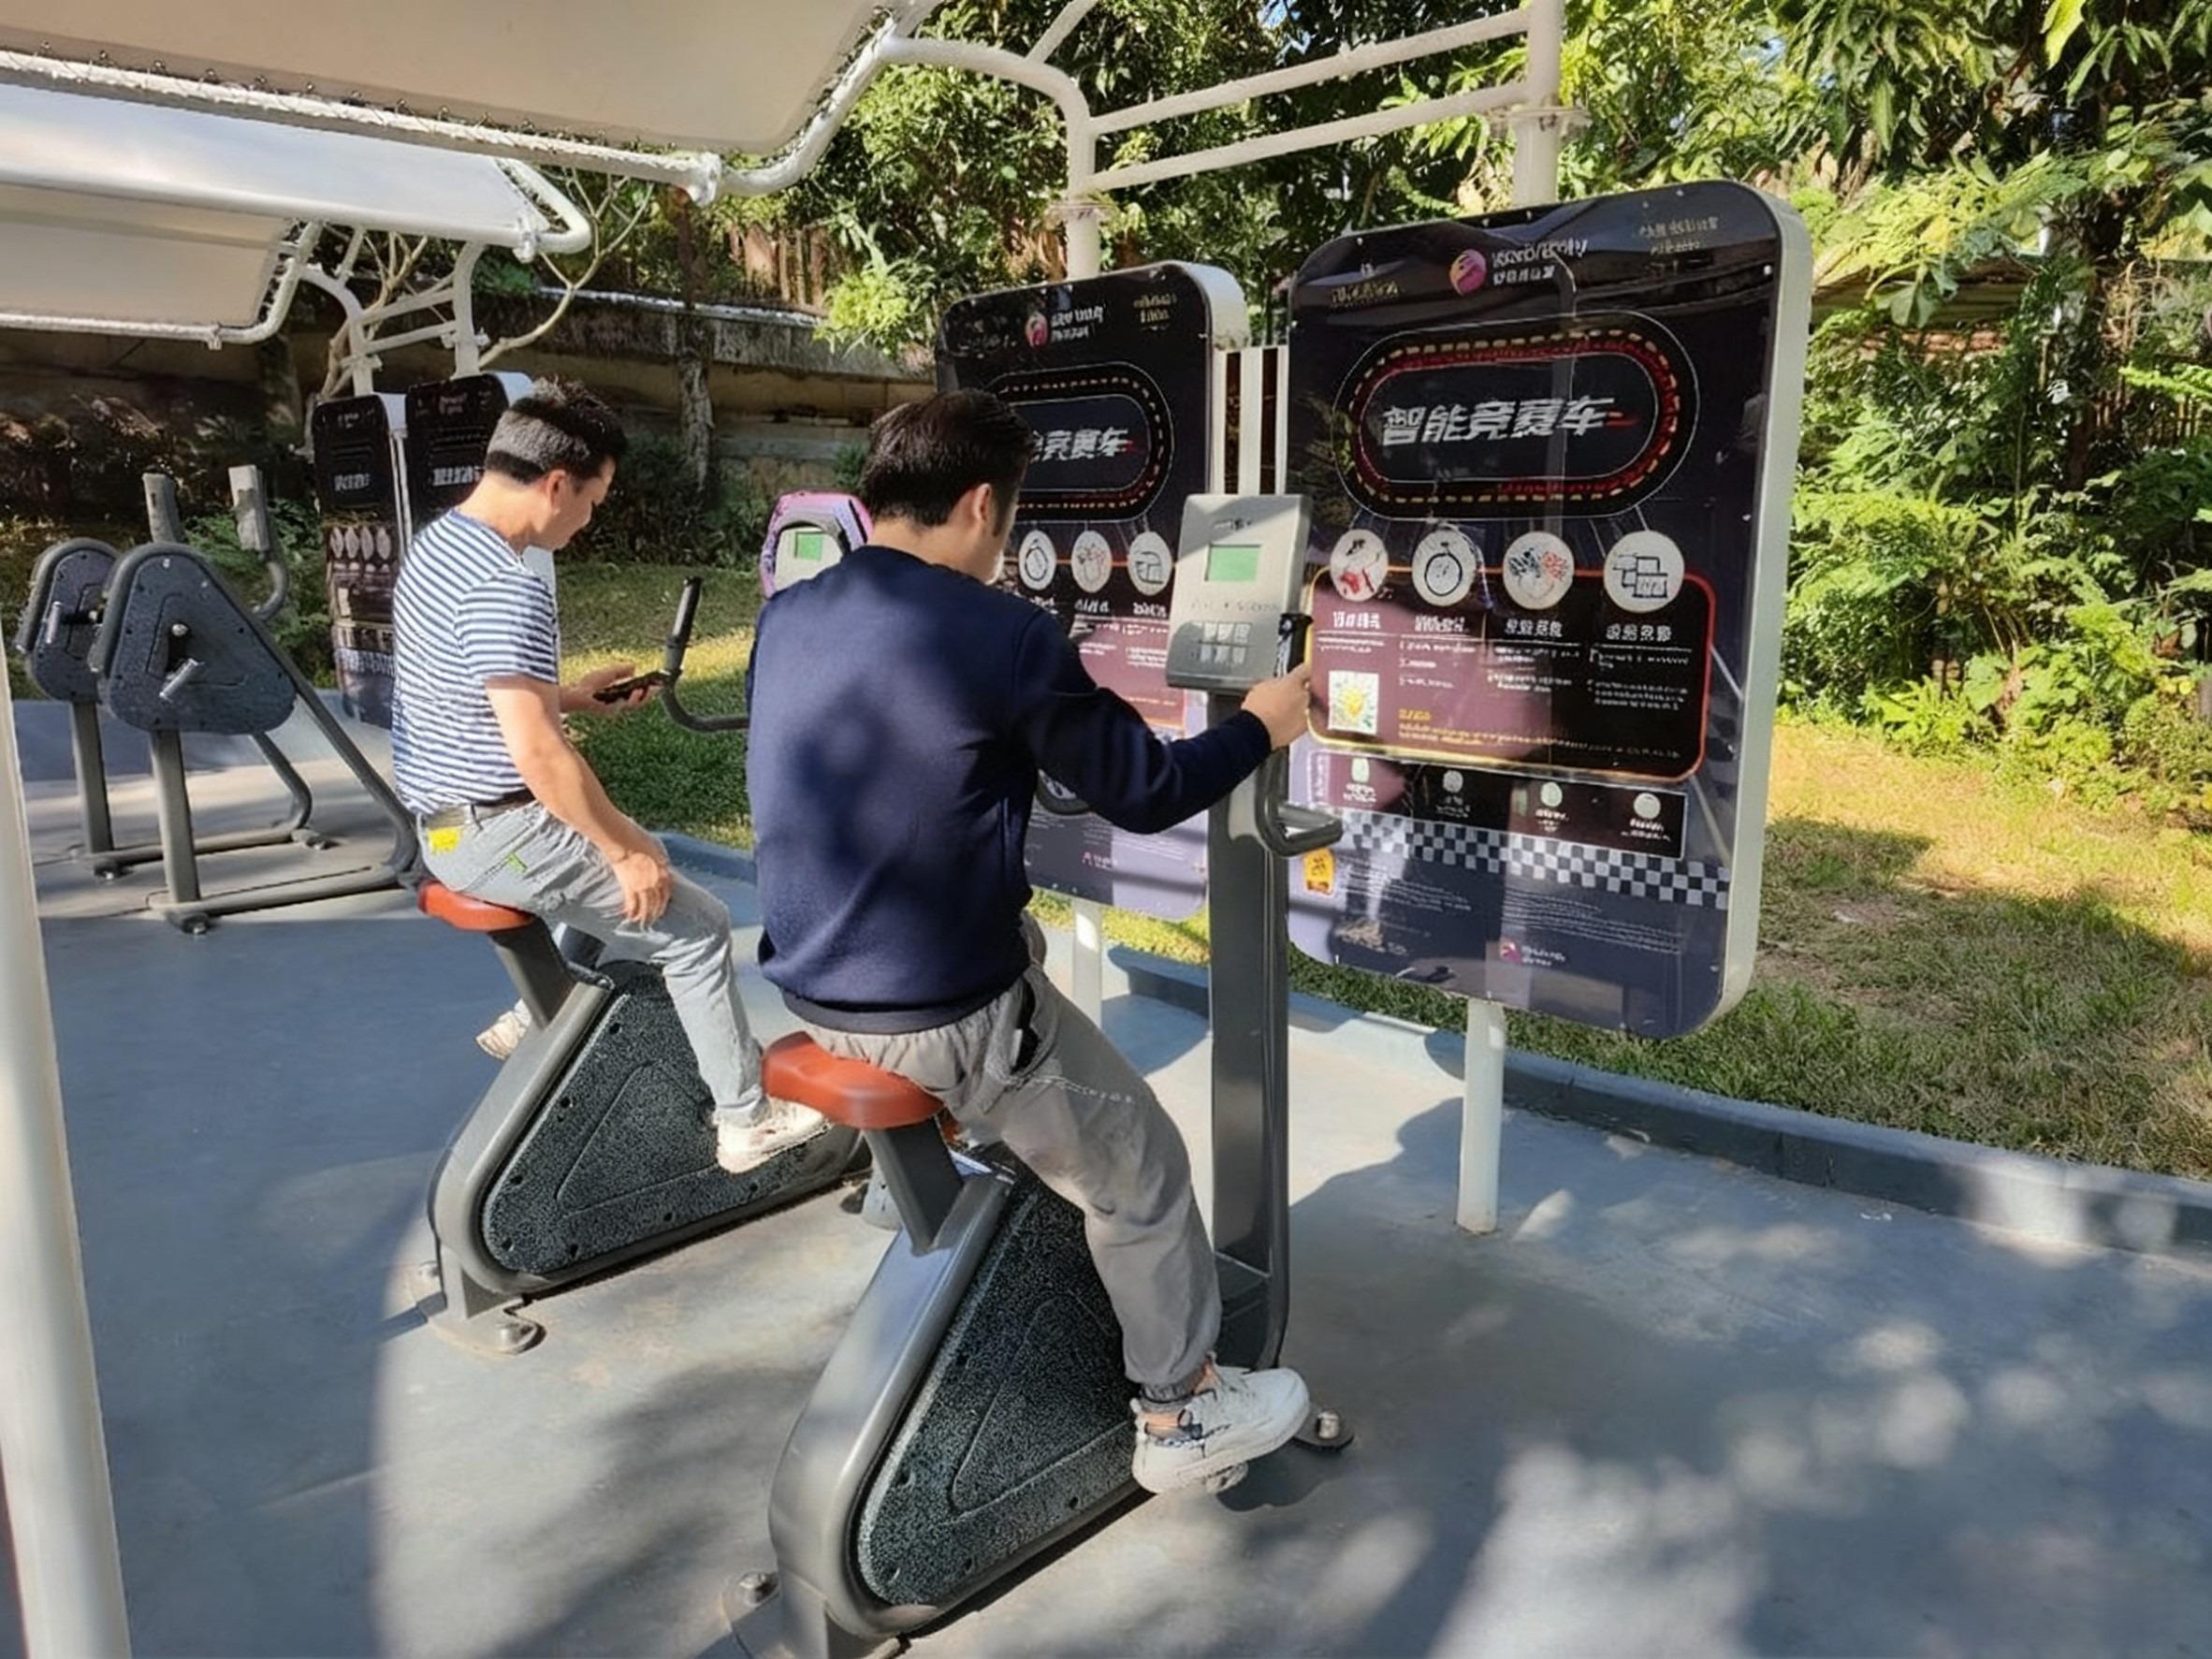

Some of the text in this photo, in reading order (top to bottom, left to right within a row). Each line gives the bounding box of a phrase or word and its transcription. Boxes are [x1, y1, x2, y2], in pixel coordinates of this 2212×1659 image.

[1382, 395, 1615, 446] 智能竞赛车
